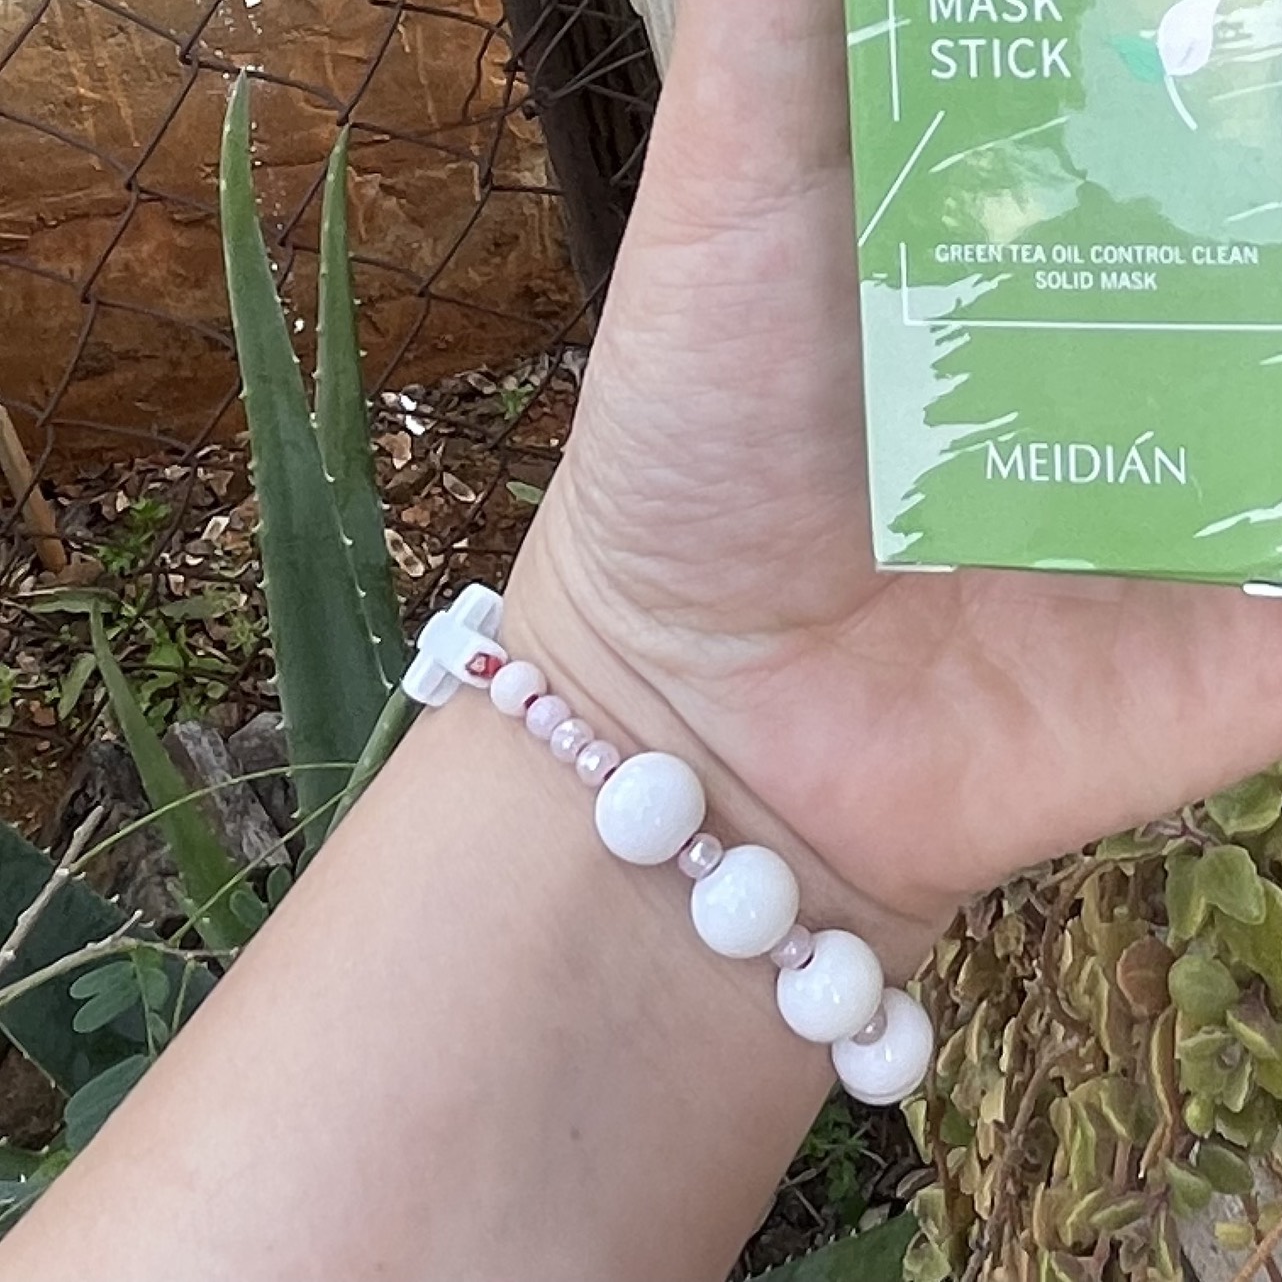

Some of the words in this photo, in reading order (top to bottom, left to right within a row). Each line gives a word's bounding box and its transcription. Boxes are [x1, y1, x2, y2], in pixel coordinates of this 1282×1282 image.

[930, 37, 1072, 79] STICK
[935, 243, 1001, 263] GREEN
[1008, 244, 1047, 263] TEA
[1052, 244, 1084, 264] OIL
[1090, 245, 1186, 265] CONTROL
[1192, 245, 1259, 265] CLEAN
[1035, 271, 1093, 290] SOLID
[1100, 271, 1158, 290] MASK
[985, 430, 1187, 485] MEIDIÁN
